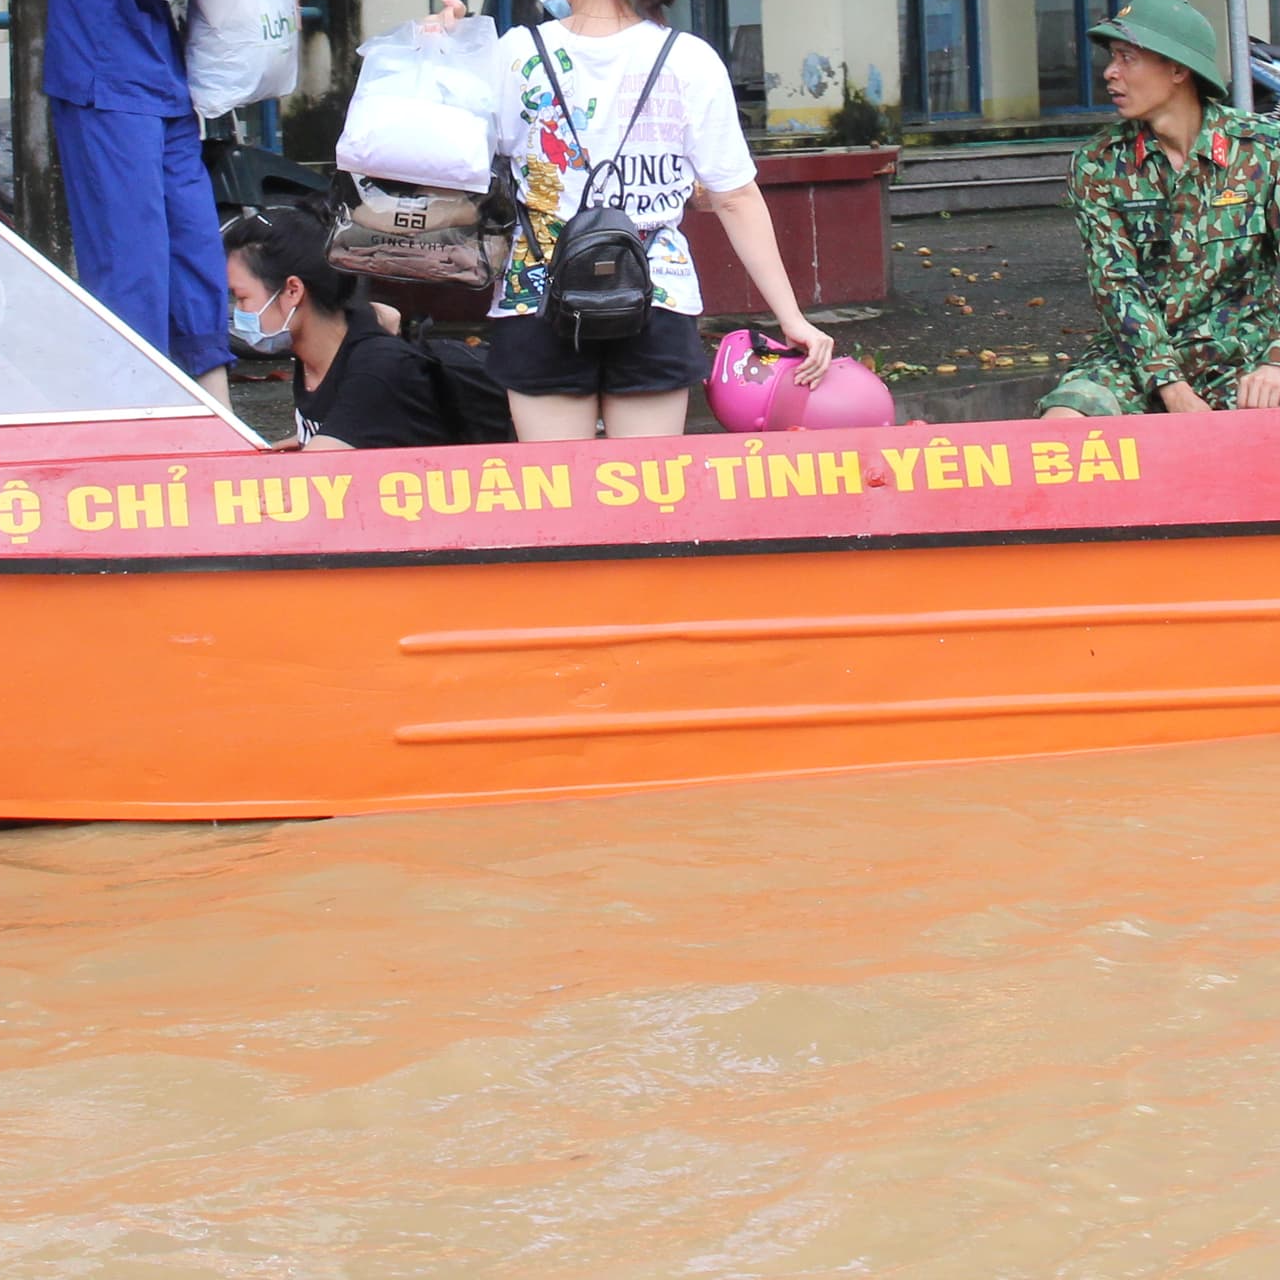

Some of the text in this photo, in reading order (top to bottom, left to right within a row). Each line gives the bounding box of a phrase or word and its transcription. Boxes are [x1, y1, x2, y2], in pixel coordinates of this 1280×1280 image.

[67, 464, 189, 532] CHỈ
[213, 473, 353, 526] HUY
[378, 457, 573, 521] QUÂN
[595, 454, 693, 514] SỰ
[708, 439, 864, 501] TỈNH
[881, 437, 1013, 492] YÊN
[1031, 429, 1142, 485] BÁI
